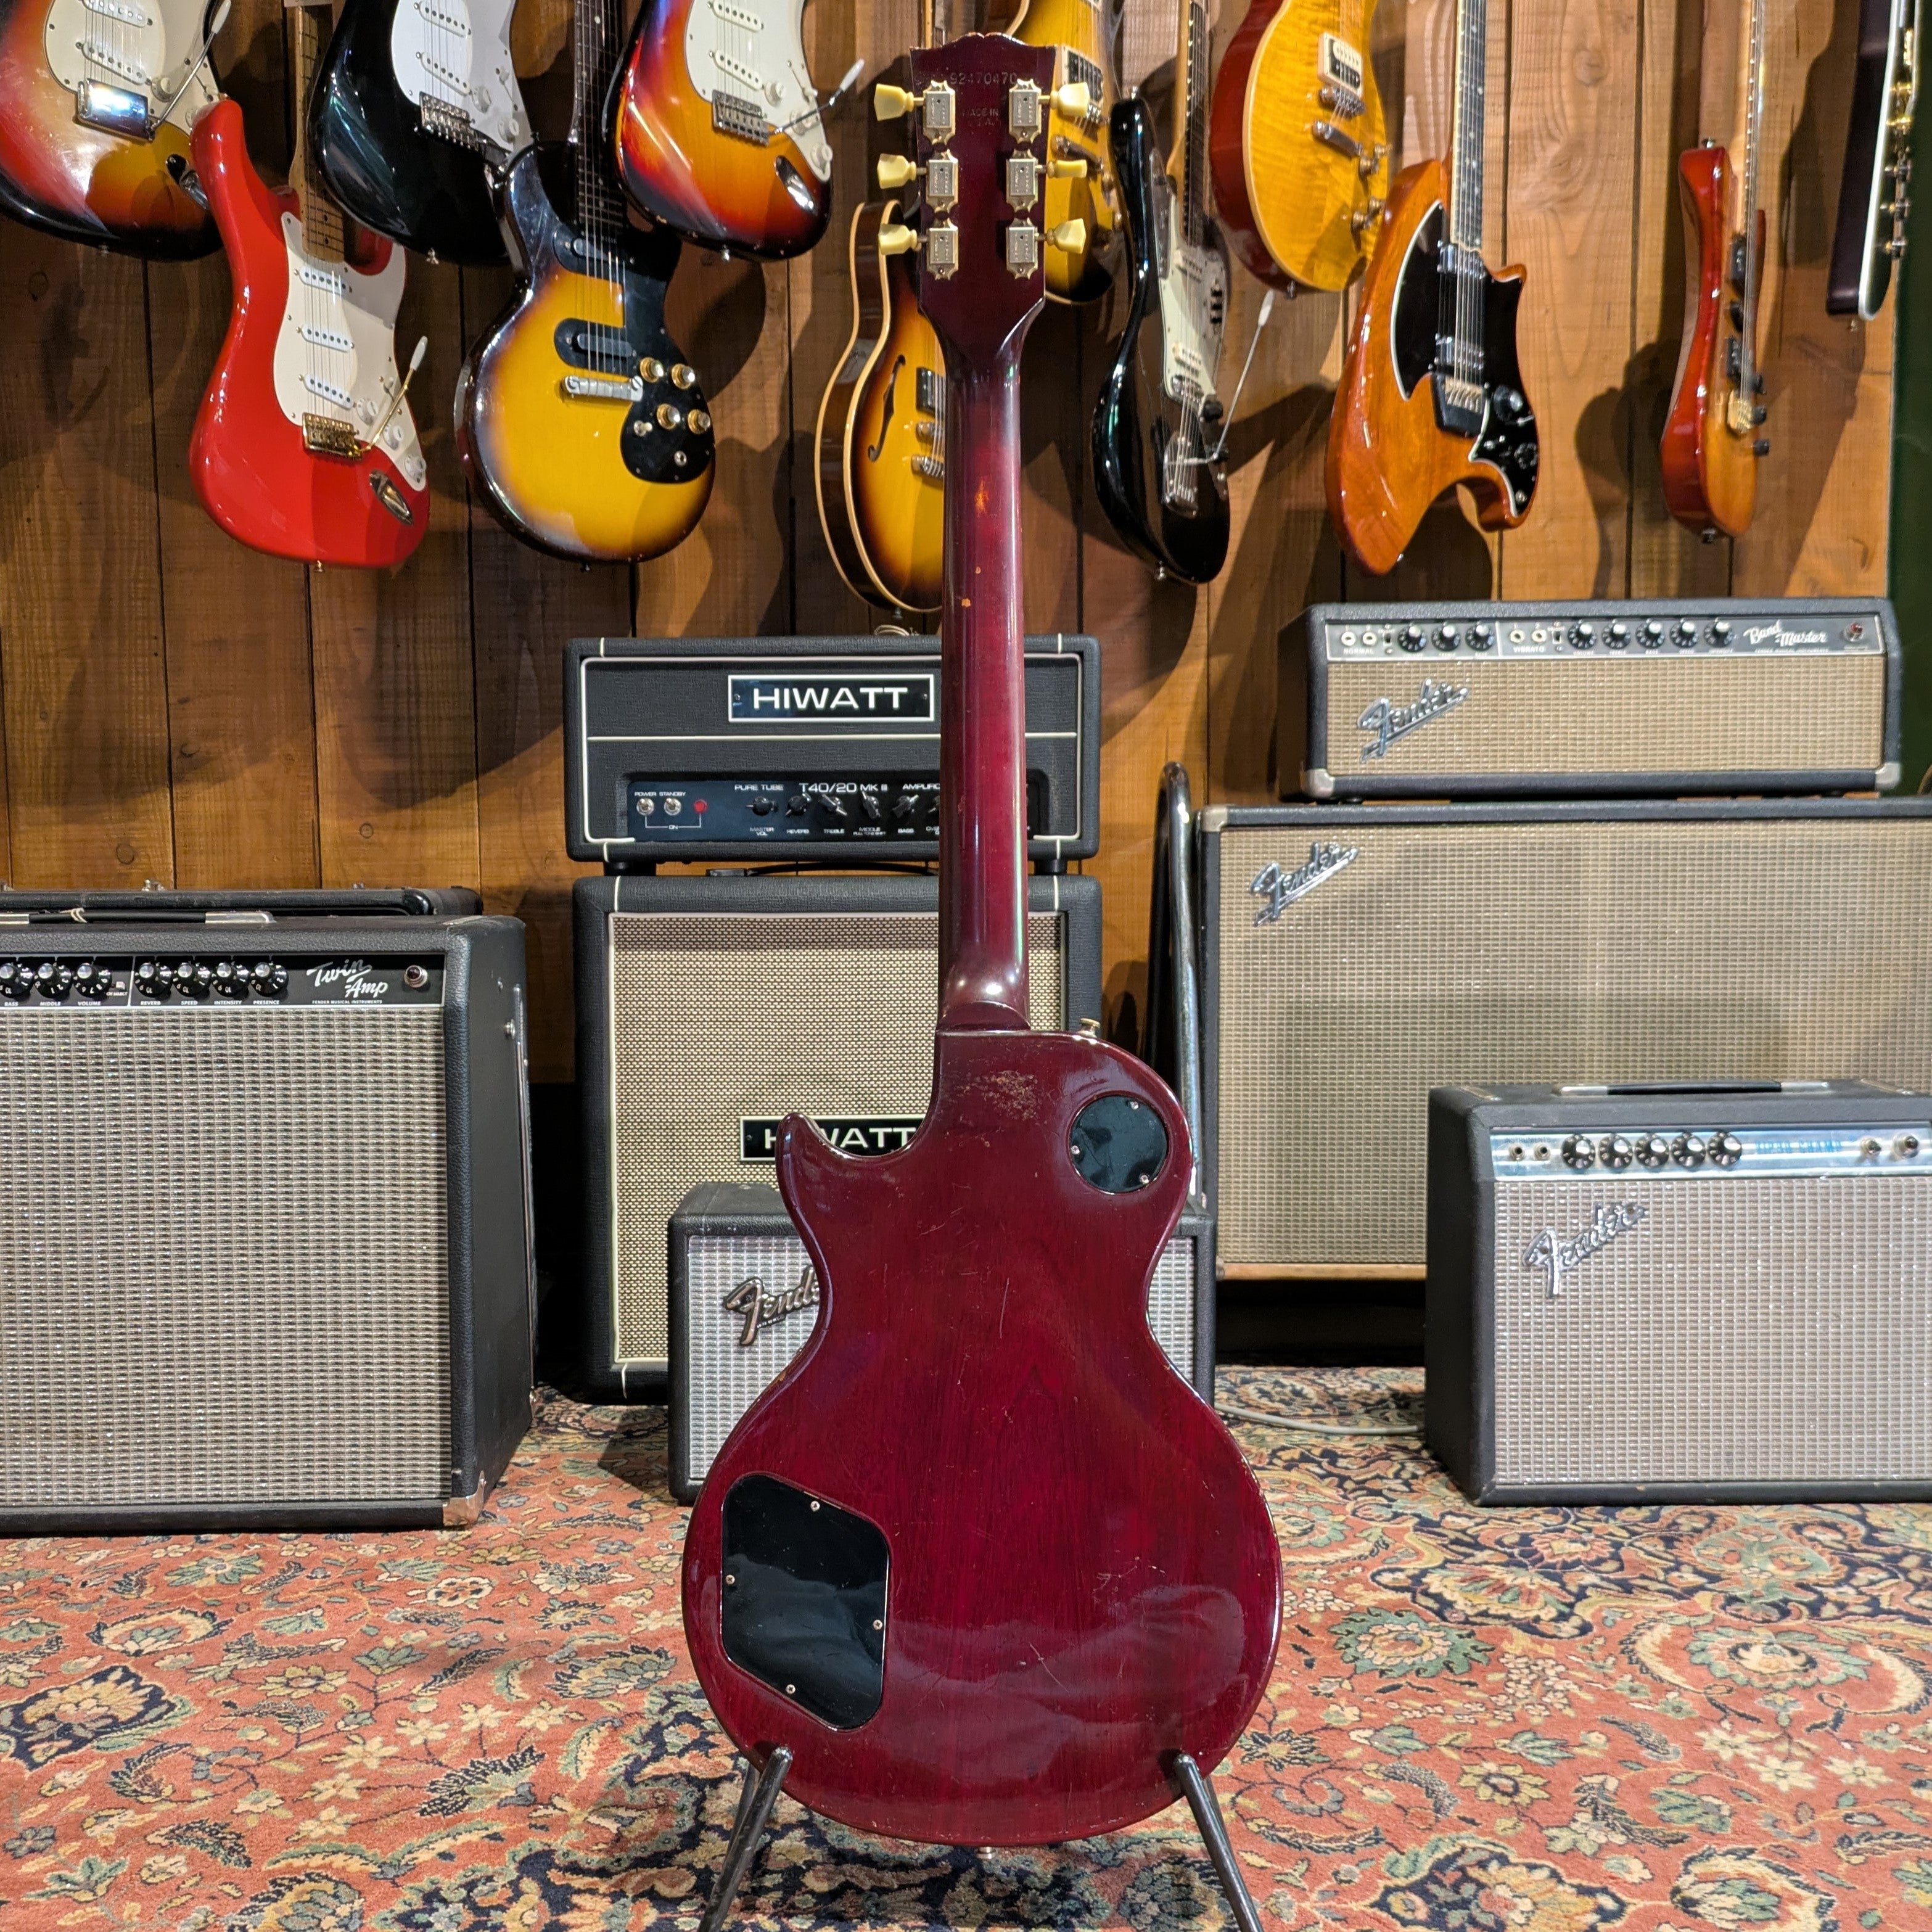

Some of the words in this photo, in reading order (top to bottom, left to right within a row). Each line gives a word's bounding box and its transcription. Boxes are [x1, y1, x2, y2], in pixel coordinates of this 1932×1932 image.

[1743, 620, 1782, 644] Band
[1775, 630, 1828, 647] Master
[753, 687, 908, 710] HIWATT
[1358, 678, 1470, 763] Fender
[799, 783, 857, 793] T40/20
[1249, 842, 1358, 927] Fender
[306, 959, 372, 987] Twin
[345, 978, 388, 998] Amp
[1523, 1202, 1650, 1298] Fender
[723, 1265, 820, 1346] Fende
